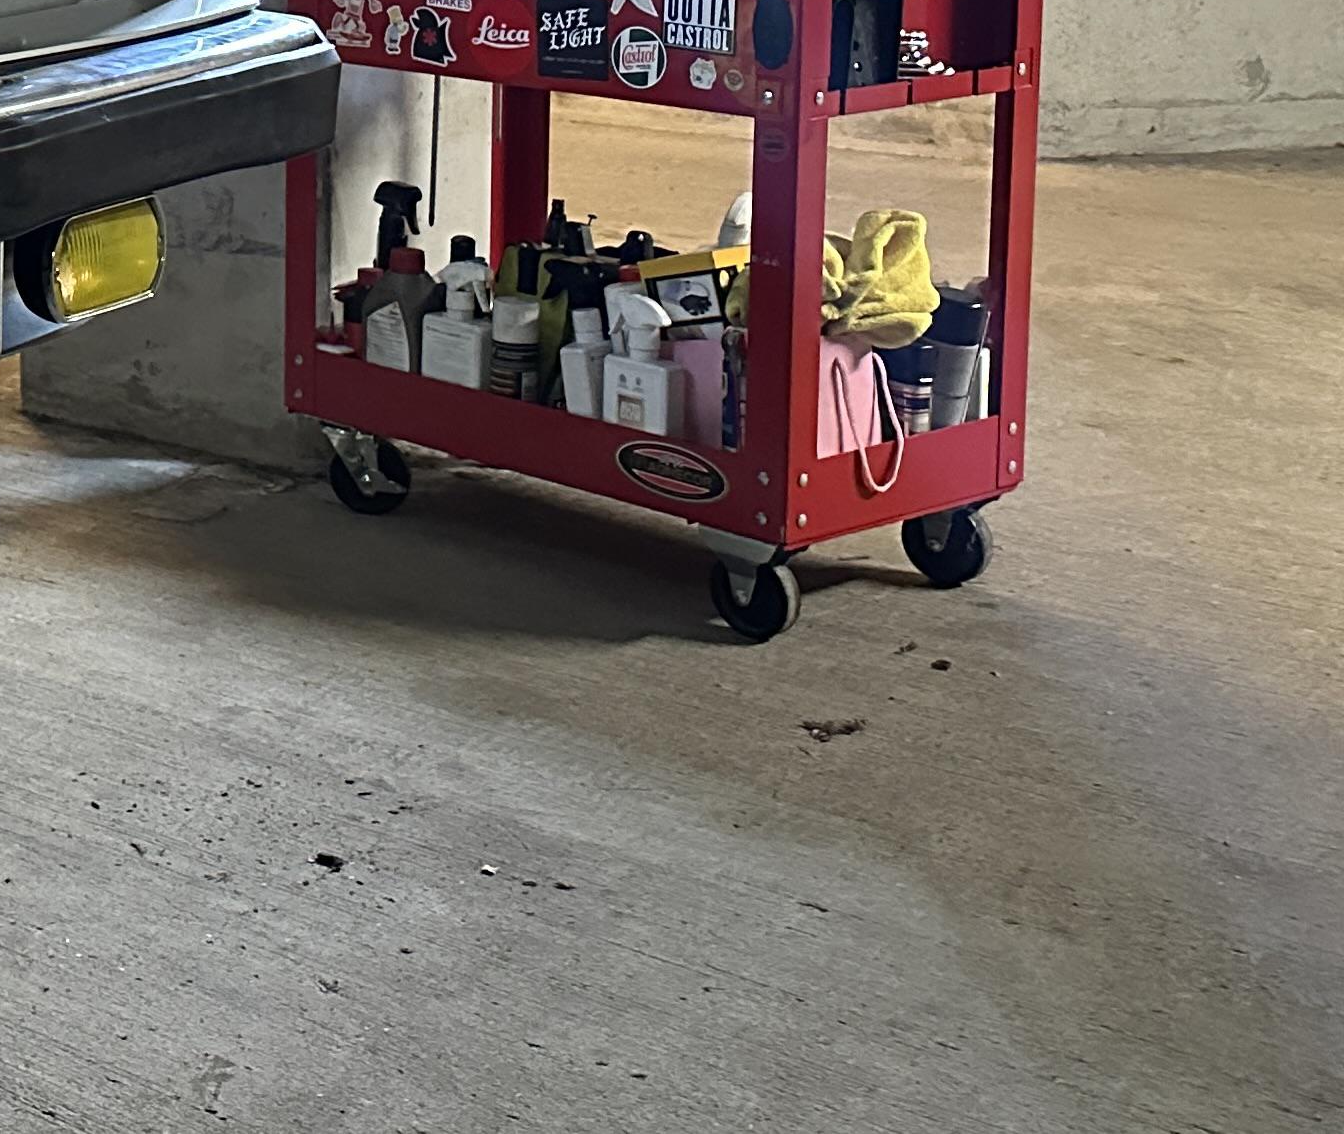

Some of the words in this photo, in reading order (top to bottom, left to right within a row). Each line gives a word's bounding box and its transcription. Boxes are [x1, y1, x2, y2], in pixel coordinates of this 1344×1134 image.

[472, 15, 530, 49] Leica
[539, 7, 591, 32] SAFE
[548, 26, 606, 51] LIGHT
[667, 23, 729, 52] CASTROL
[622, 44, 657, 70] Castrol
